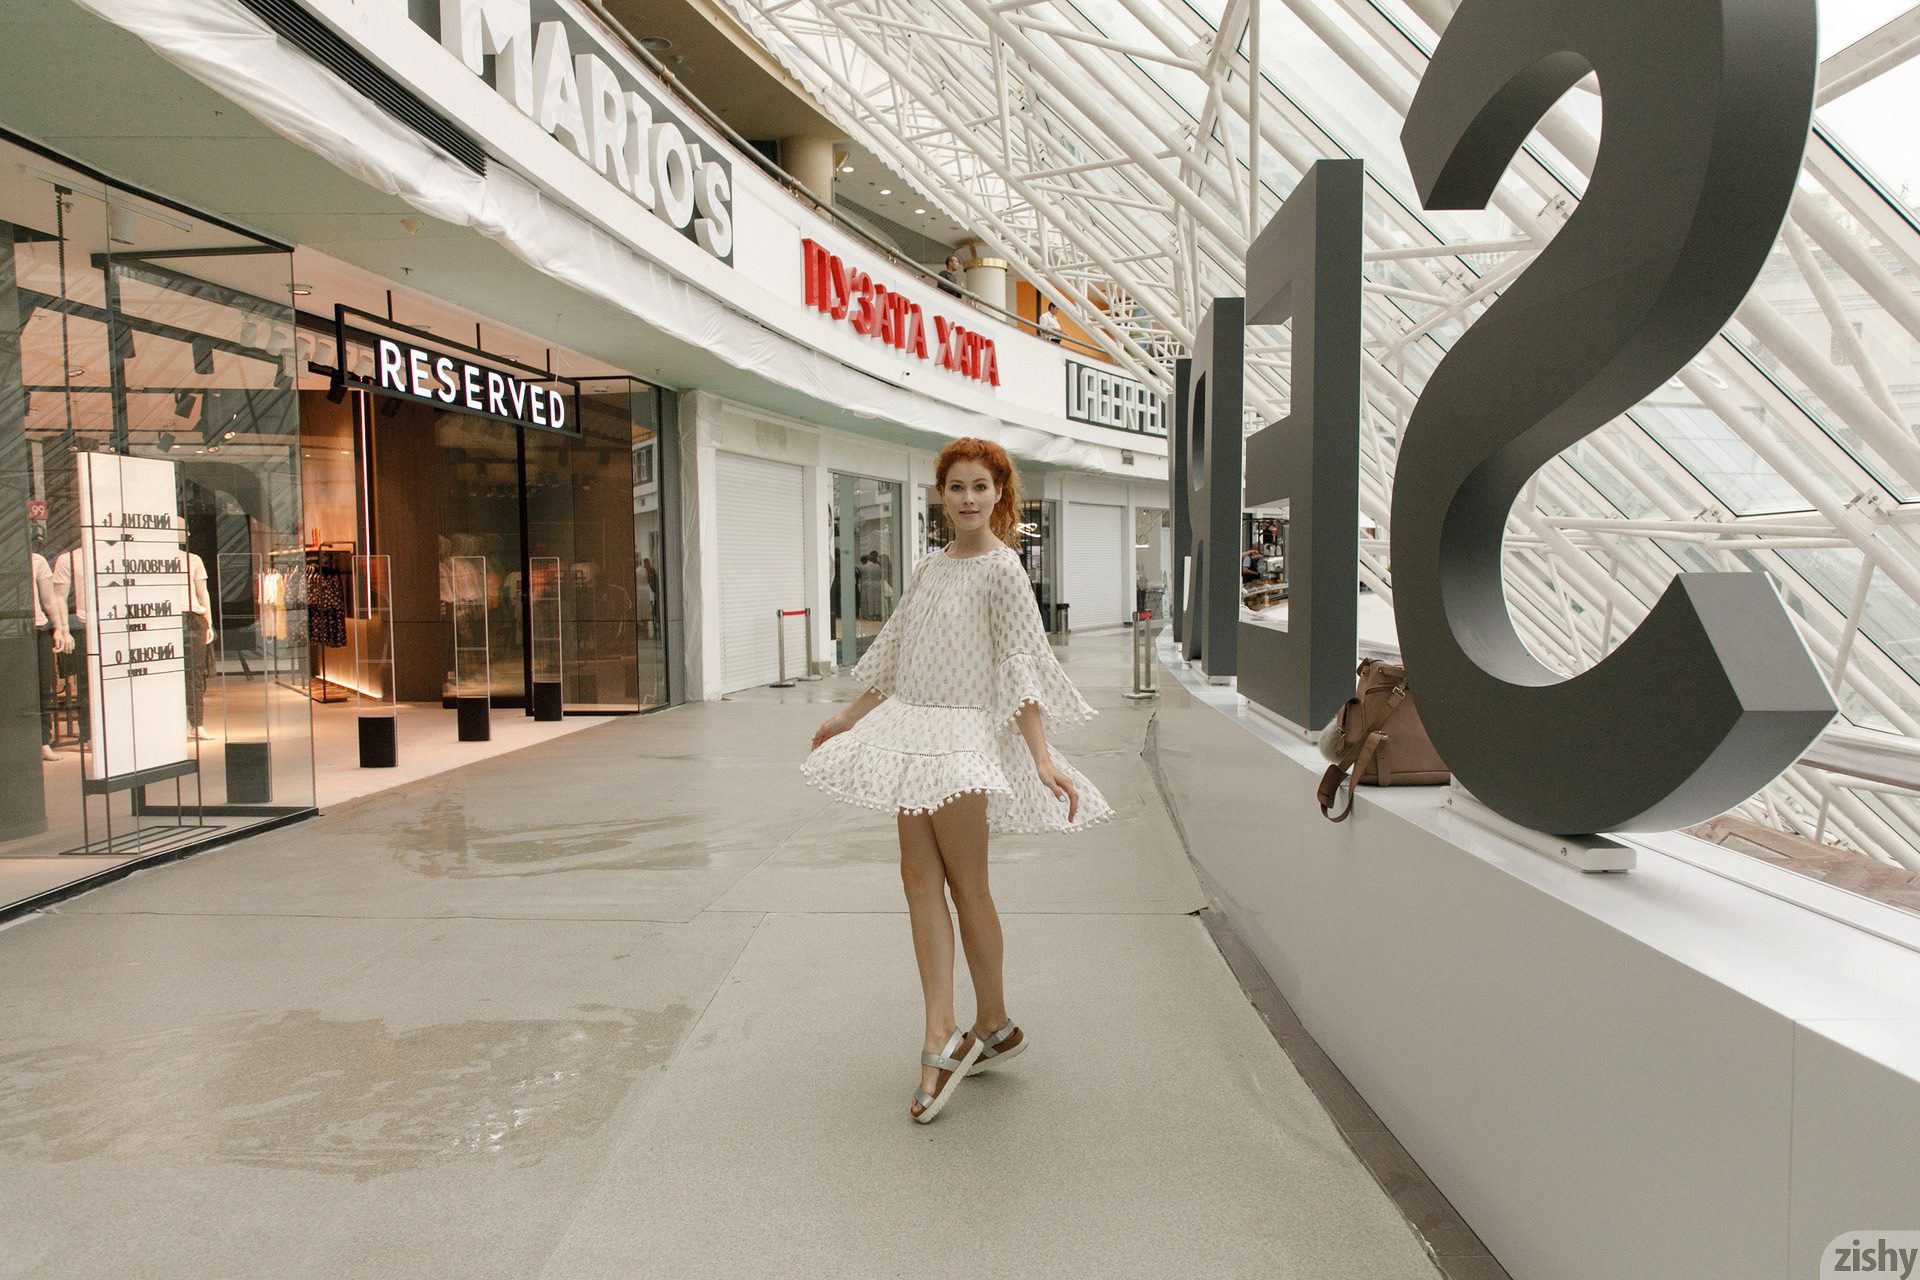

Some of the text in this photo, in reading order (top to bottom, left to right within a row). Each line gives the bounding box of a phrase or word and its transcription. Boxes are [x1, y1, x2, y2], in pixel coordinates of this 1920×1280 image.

[802, 238, 1000, 387] ПУЗАТА ХАТА
[379, 339, 565, 429] RESERVED
[1068, 362, 1168, 436] LAGERFEL
